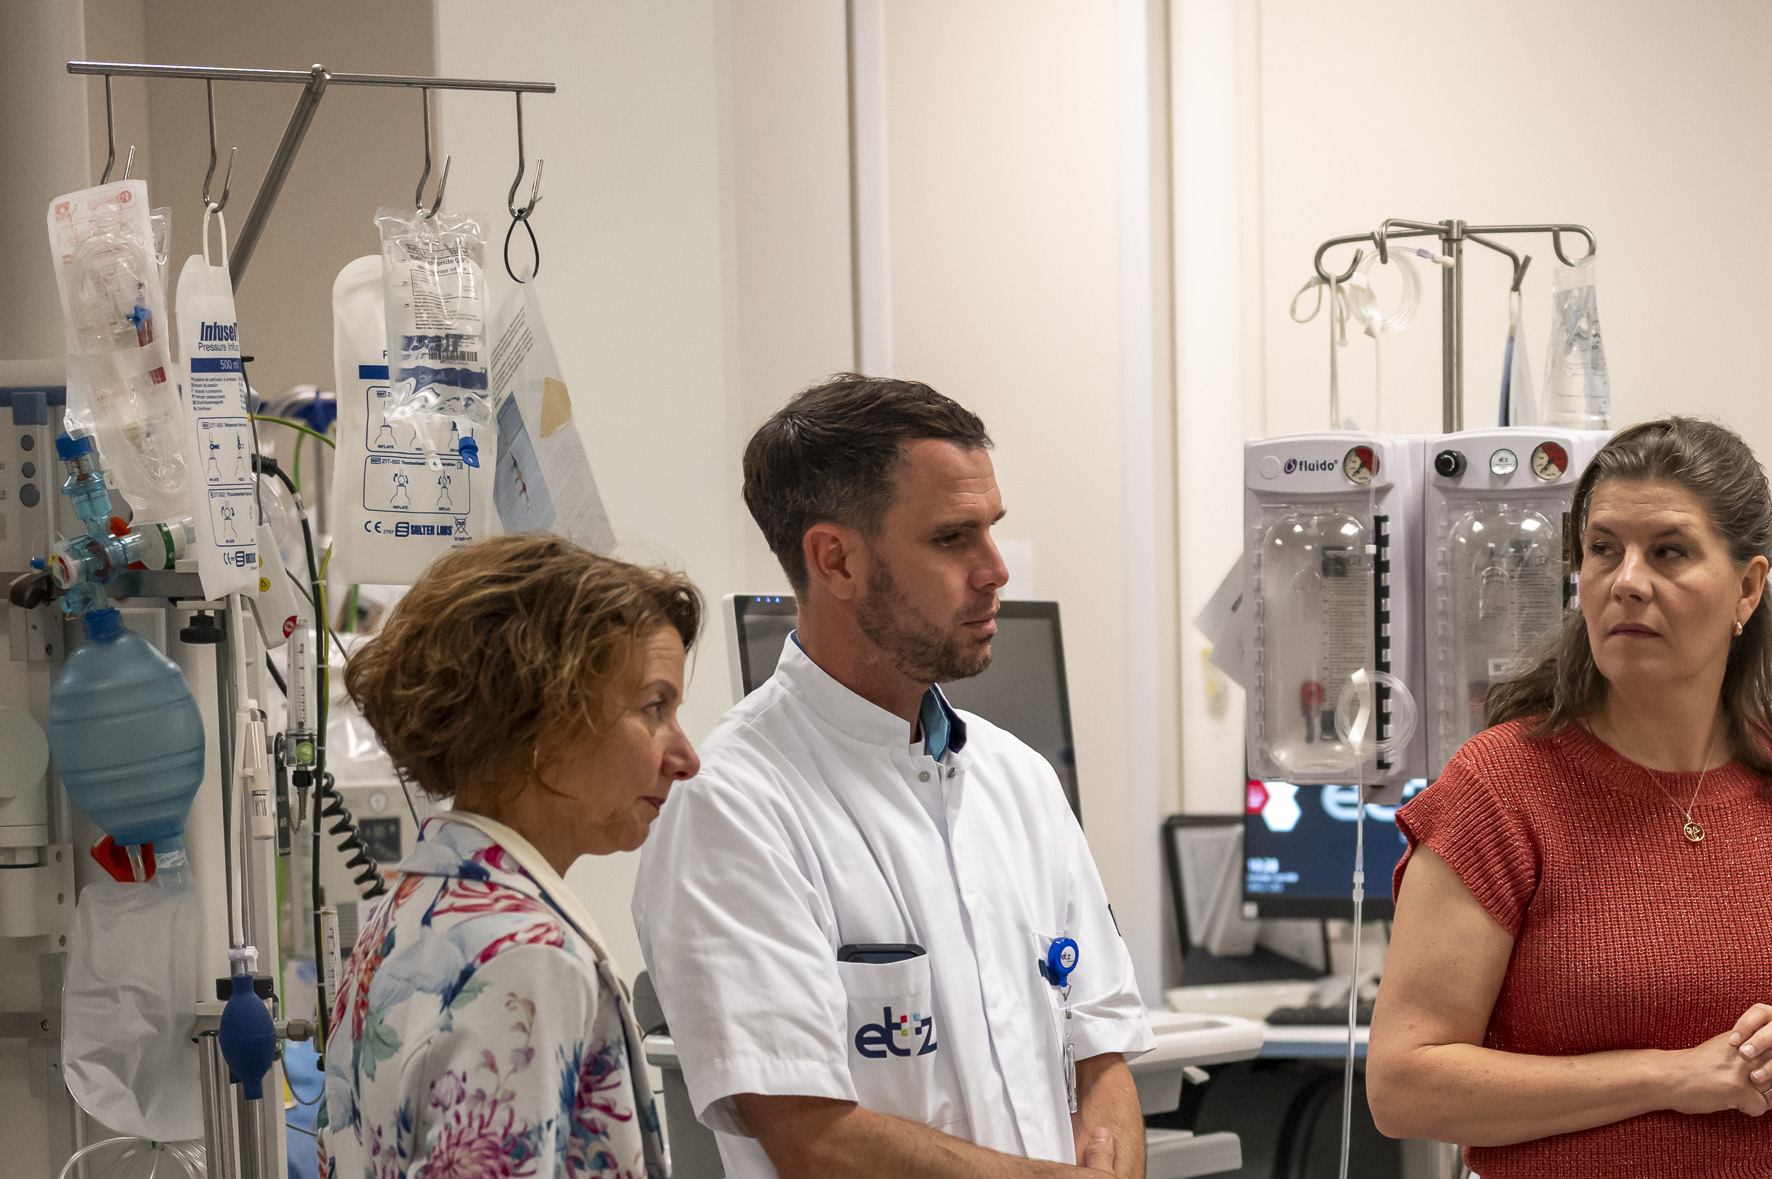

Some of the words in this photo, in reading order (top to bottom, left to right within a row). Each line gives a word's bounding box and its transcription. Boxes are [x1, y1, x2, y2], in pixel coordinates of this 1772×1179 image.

[198, 342, 226, 352] Pressure
[220, 360, 233, 370] 500
[855, 1006, 938, 1059] etz
